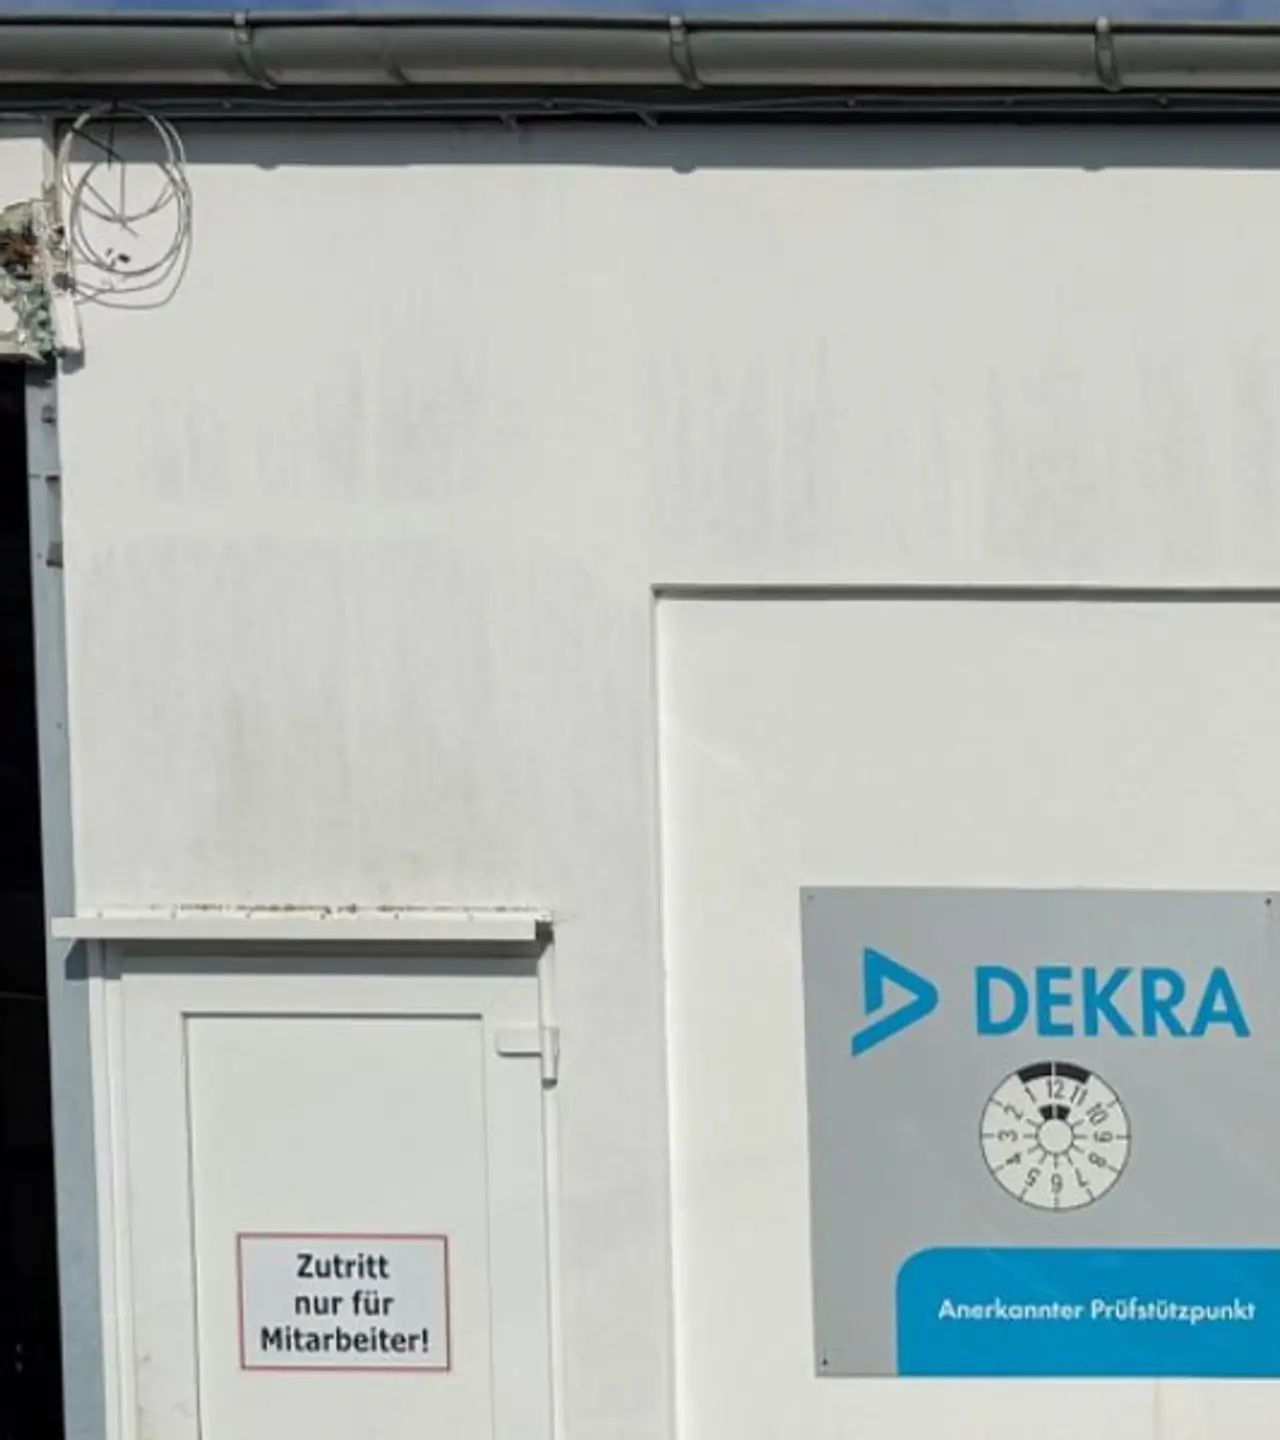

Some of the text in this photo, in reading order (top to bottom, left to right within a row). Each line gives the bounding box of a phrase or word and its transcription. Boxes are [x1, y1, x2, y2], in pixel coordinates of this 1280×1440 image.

[973, 965, 1251, 1038] DEKRA
[1046, 1080, 1065, 1099] 12
[297, 1253, 390, 1279] Zutritt
[295, 1289, 394, 1316] nur für
[937, 1297, 1256, 1325] Anerkannter Prüfstützpunkt
[260, 1326, 429, 1353] Mitarbeiter!
